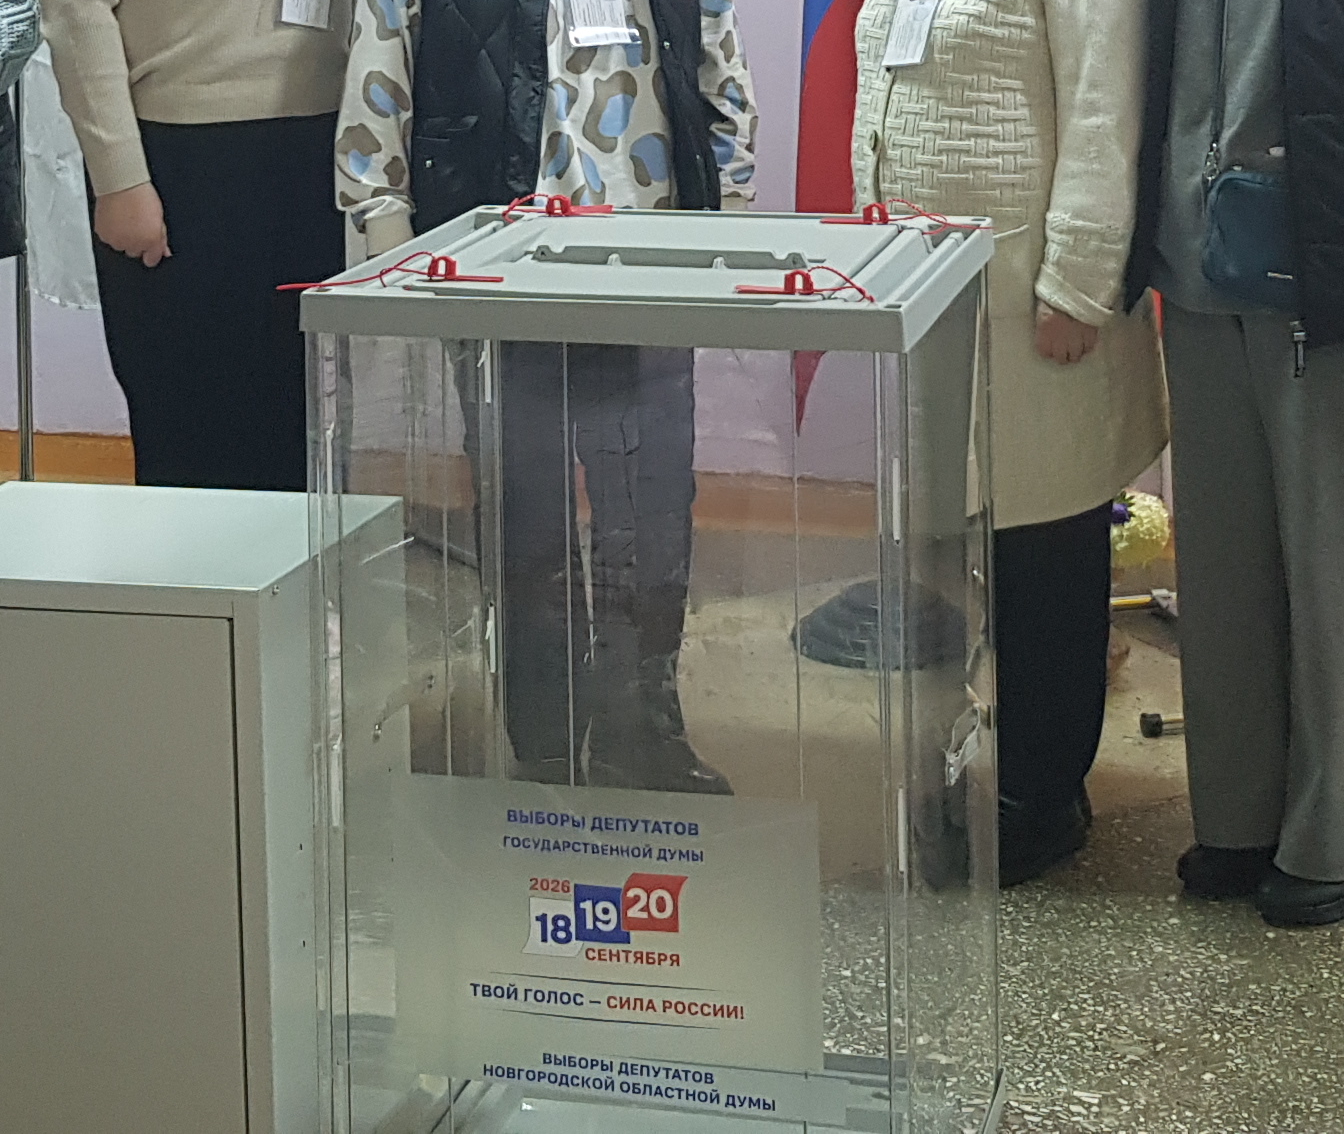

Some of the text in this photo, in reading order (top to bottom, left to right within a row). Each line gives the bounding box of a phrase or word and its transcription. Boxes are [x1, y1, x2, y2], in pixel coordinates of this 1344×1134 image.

[507, 809, 700, 836] ВЫБОРЫ ДЕПУТАТОВ
[503, 836, 704, 862] ГОСУДАРСТВЕННОЙ ДУМЫ
[529, 877, 571, 893] 2026
[535, 887, 674, 944] 18 19 20
[584, 947, 681, 967] СЕНТЯБРЯ
[470, 983, 518, 1001] ТВОЙ
[523, 988, 584, 1006] ГОЛОС
[606, 995, 657, 1013] СИЛА
[662, 999, 745, 1020] РОССИИ!
[542, 1052, 715, 1085] ВЫБОРЫ ДЕПУТАТОВ
[483, 1063, 776, 1112] НОВГОРОДСКОЙ ОБЛАСТНОЙ ДУМЫ
